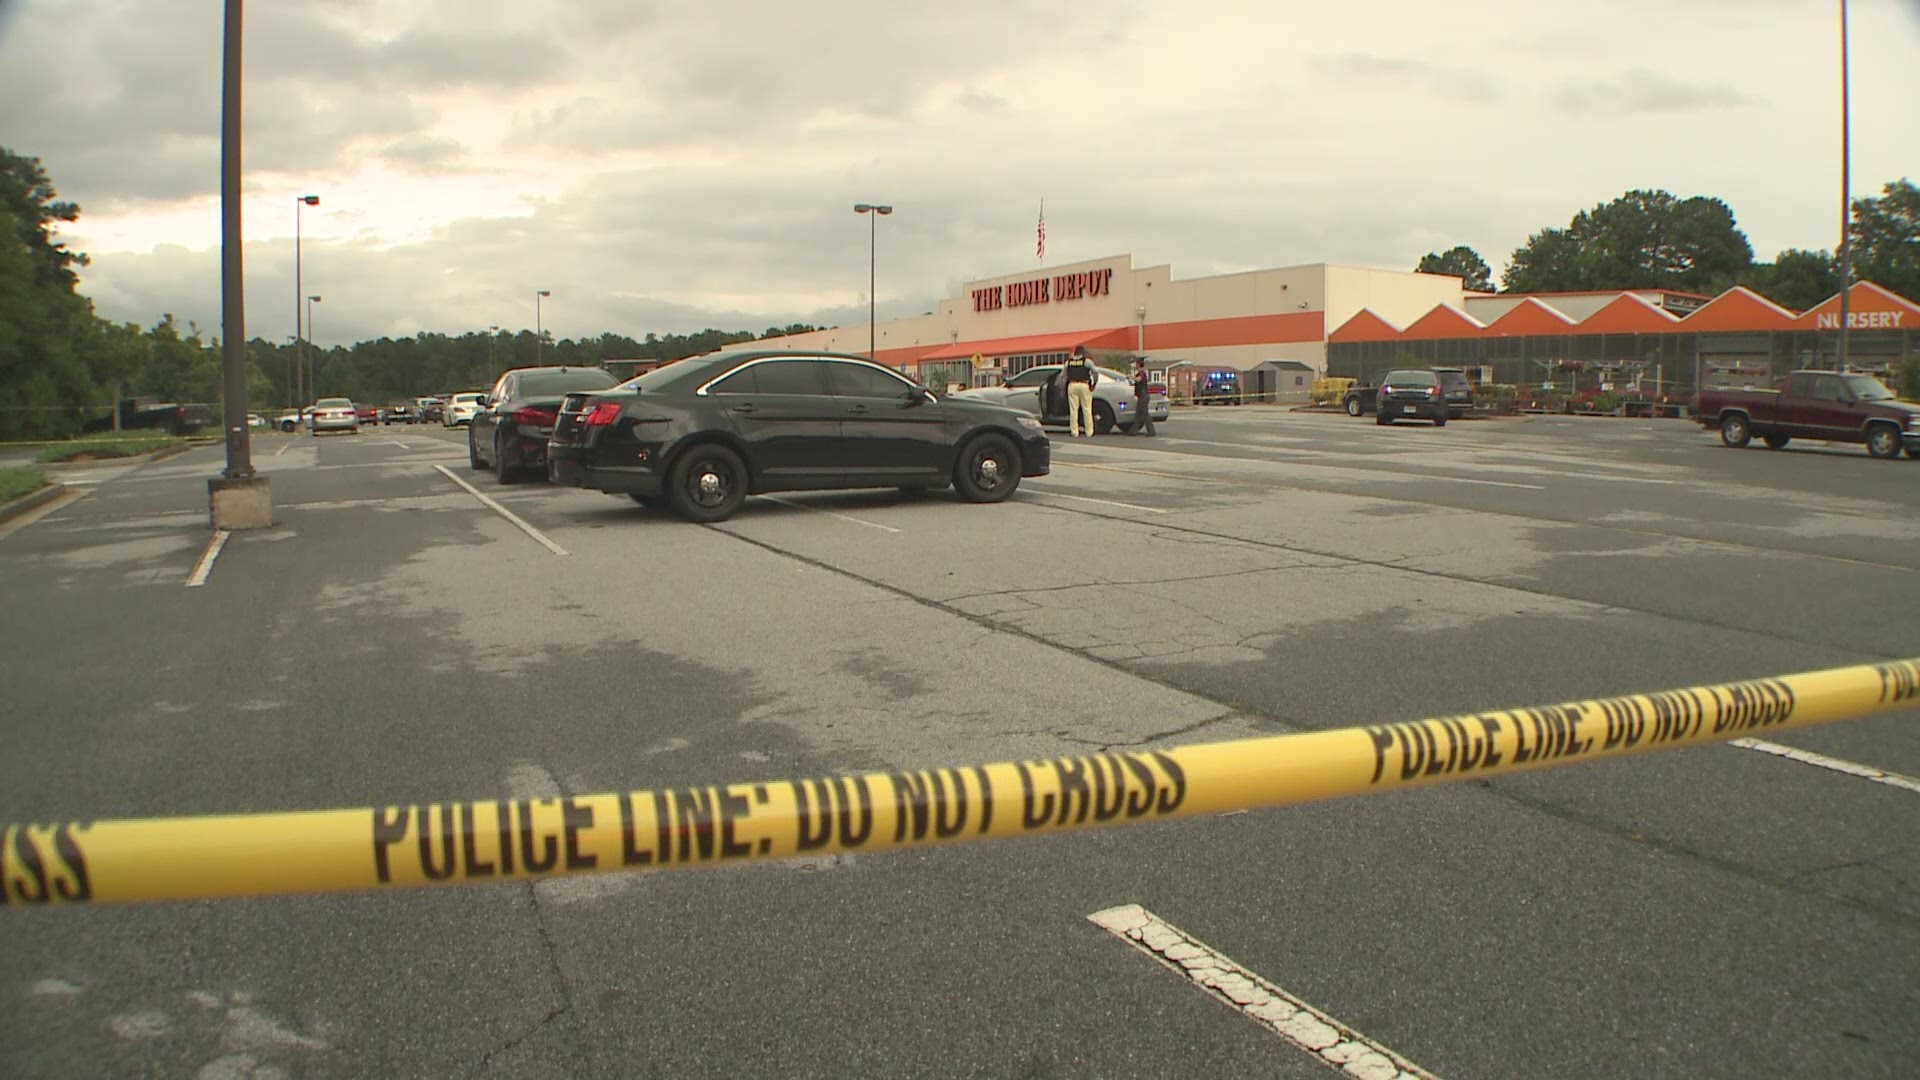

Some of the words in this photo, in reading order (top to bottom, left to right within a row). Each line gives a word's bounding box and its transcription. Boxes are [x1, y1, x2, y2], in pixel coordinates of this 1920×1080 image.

[972, 286, 1002, 312] THE
[1005, 278, 1049, 307] HOME
[1053, 268, 1112, 300] DEPOT
[1817, 312, 1904, 329] NURSERY
[1370, 715, 1501, 784] POLICE
[1601, 699, 1645, 749] DO
[1709, 681, 1794, 734] CROSS
[373, 796, 597, 883] POLICE
[795, 774, 873, 850] DO
[1017, 750, 1186, 829] CROSS
